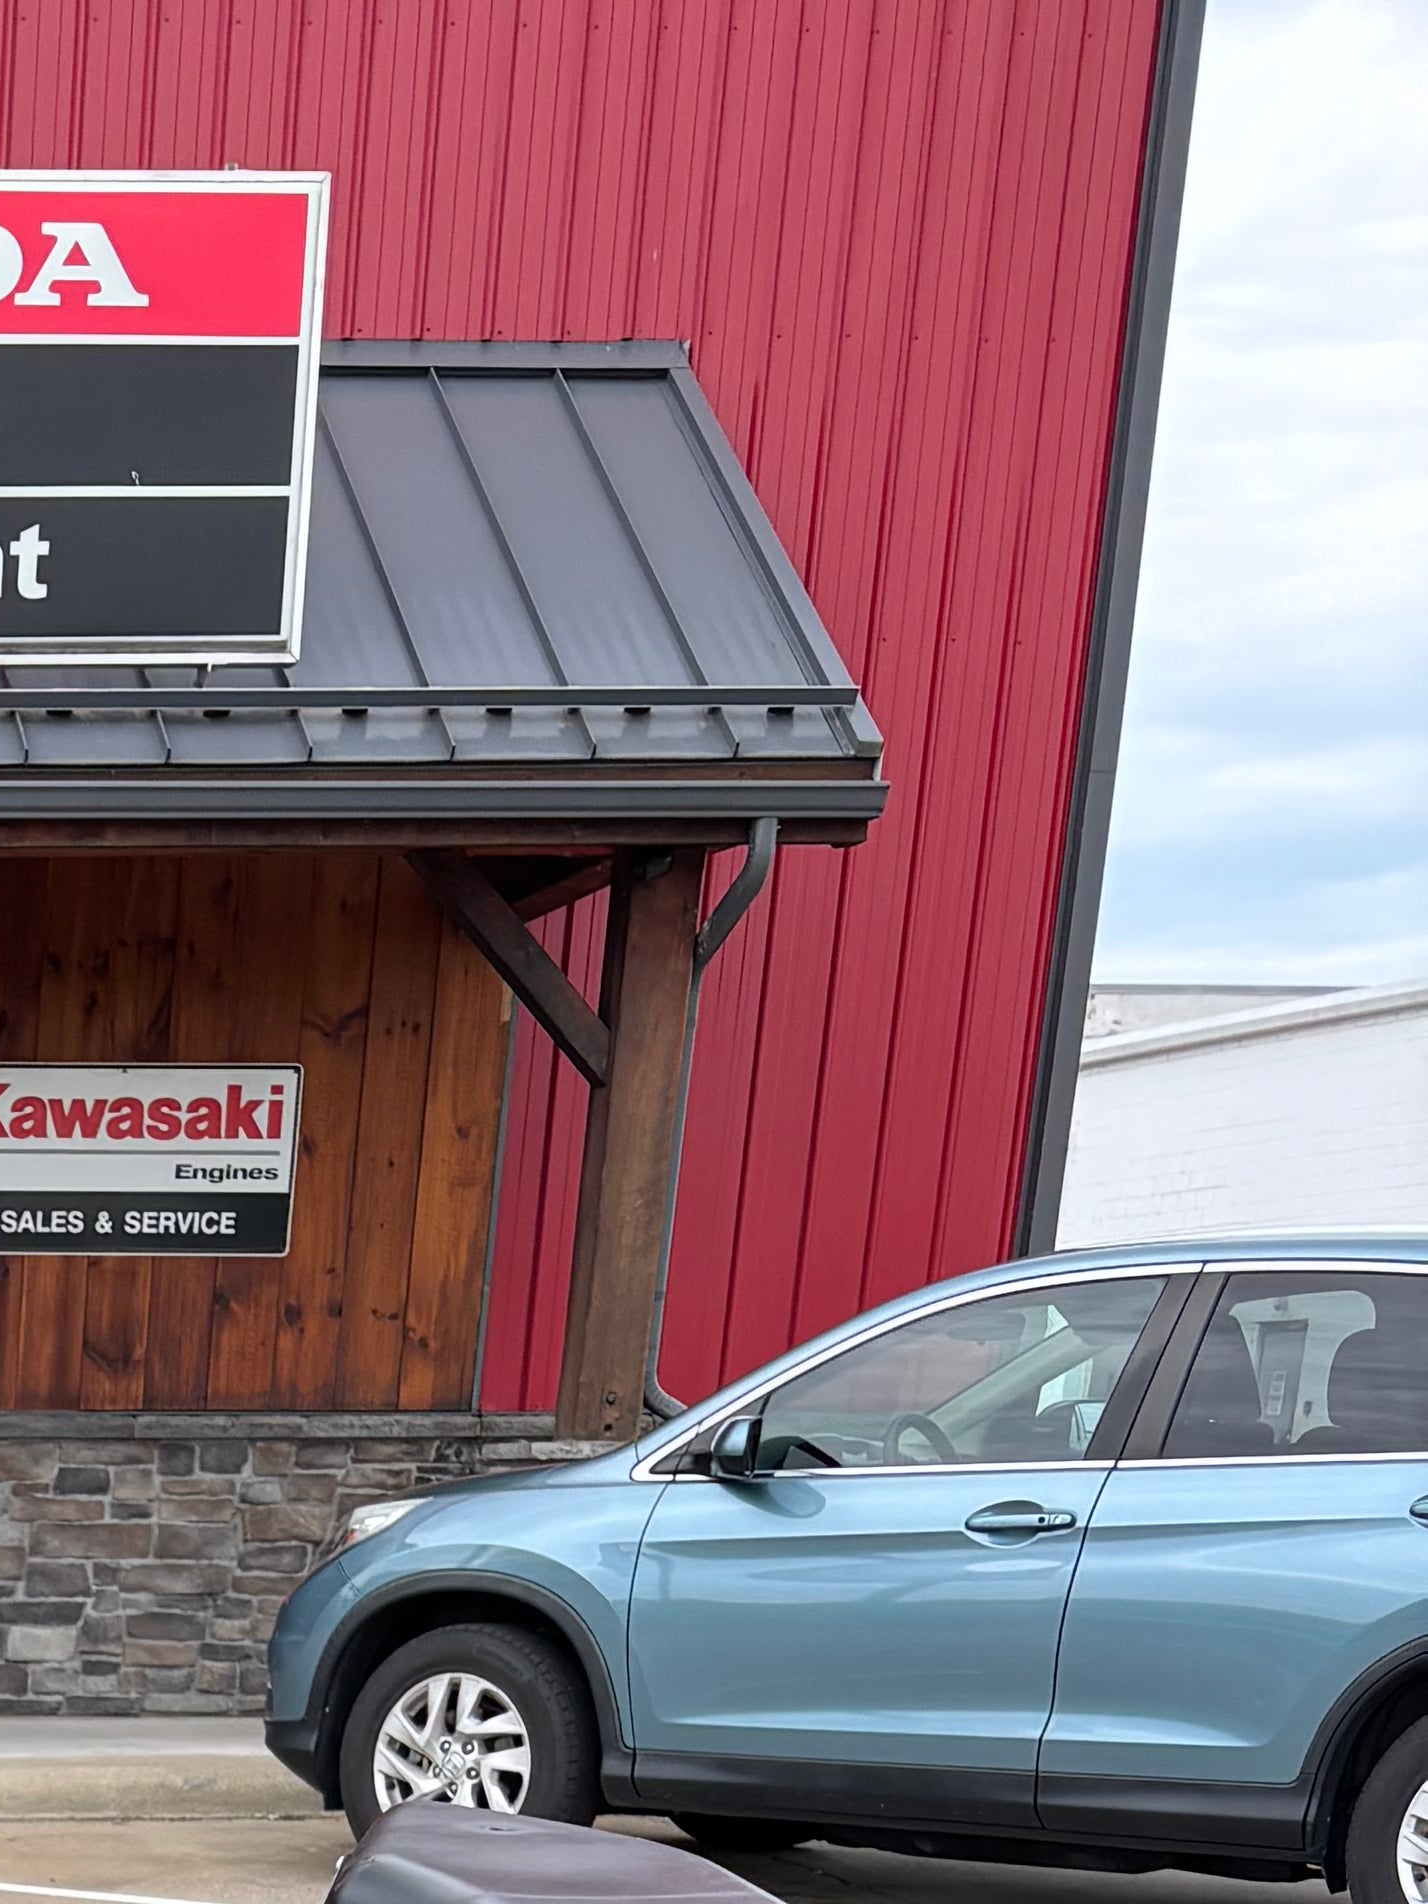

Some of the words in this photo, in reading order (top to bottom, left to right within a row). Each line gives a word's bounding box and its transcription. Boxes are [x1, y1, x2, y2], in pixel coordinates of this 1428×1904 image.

[174, 1163, 280, 1184] Engines
[0, 1209, 85, 1235] SALES
[95, 1210, 113, 1235] &
[123, 1210, 237, 1235] SERVICE
